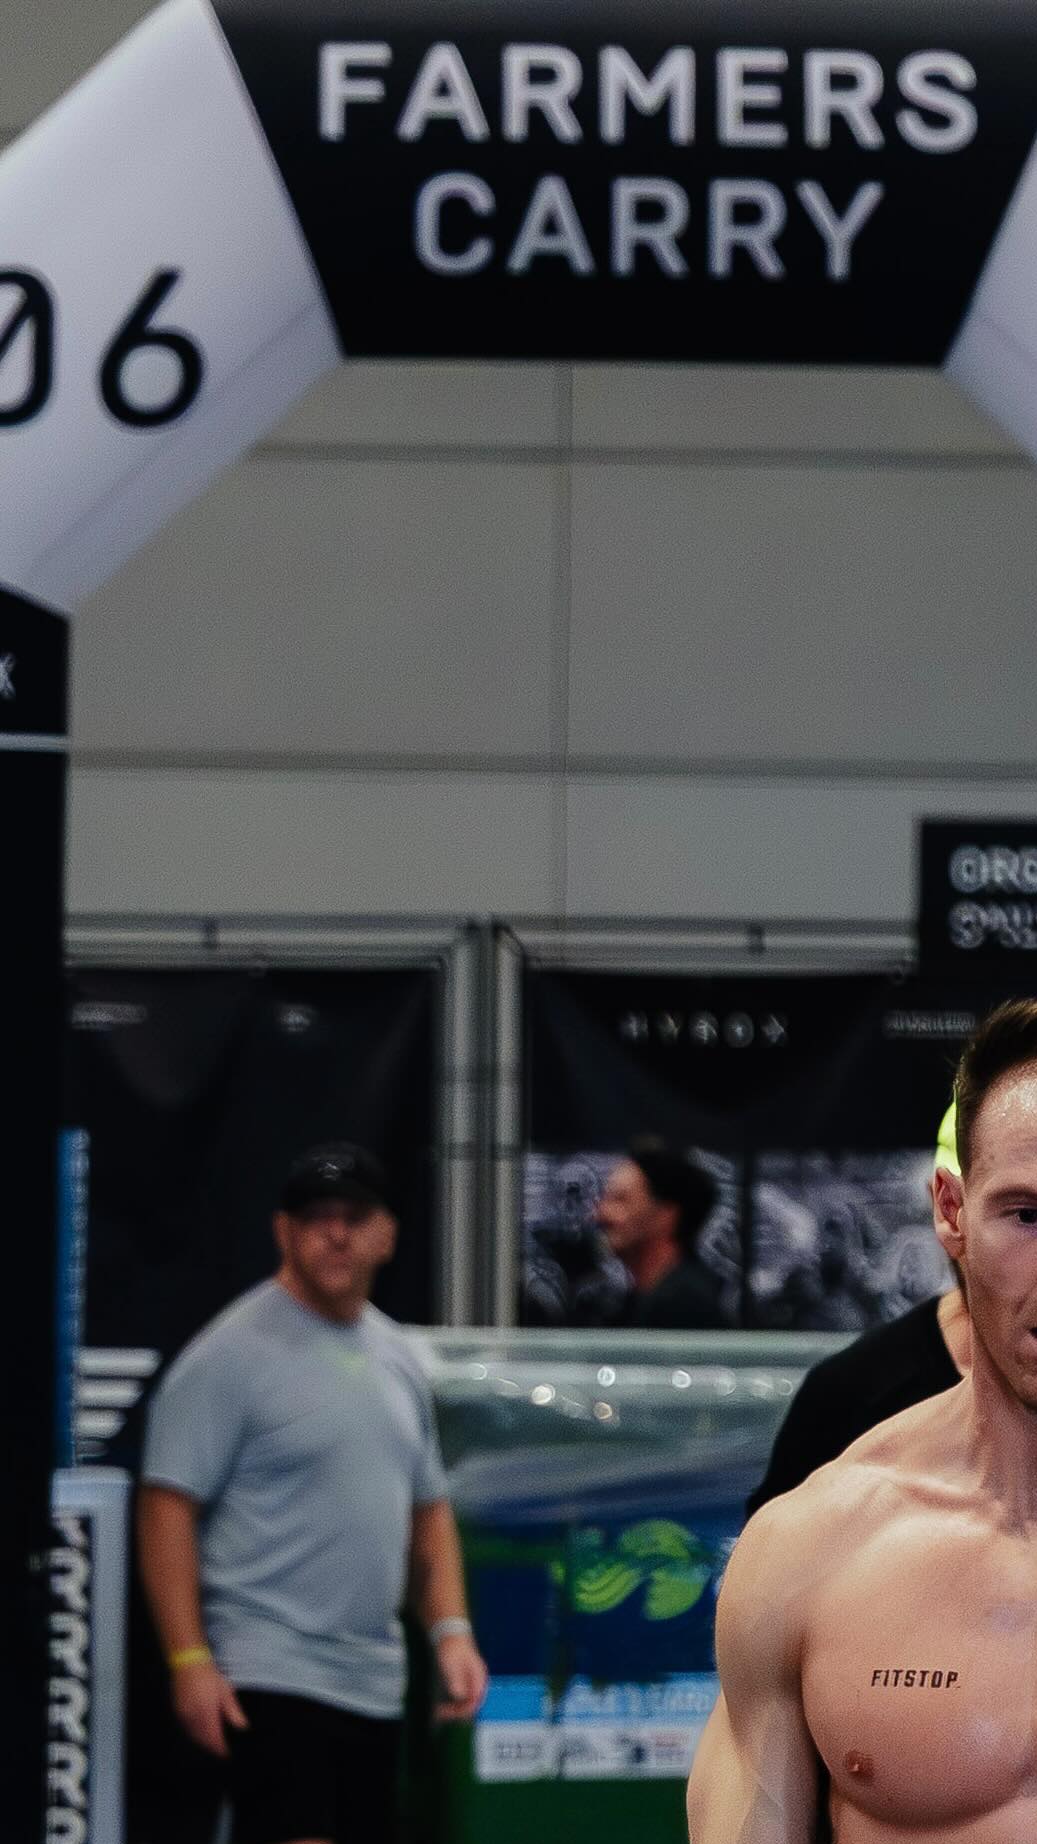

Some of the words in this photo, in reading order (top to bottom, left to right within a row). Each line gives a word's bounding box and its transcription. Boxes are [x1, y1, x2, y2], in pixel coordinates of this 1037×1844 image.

[317, 41, 980, 155] FARMERS
[413, 171, 884, 282] CARRY
[870, 1668, 960, 1689] FITSTOP
